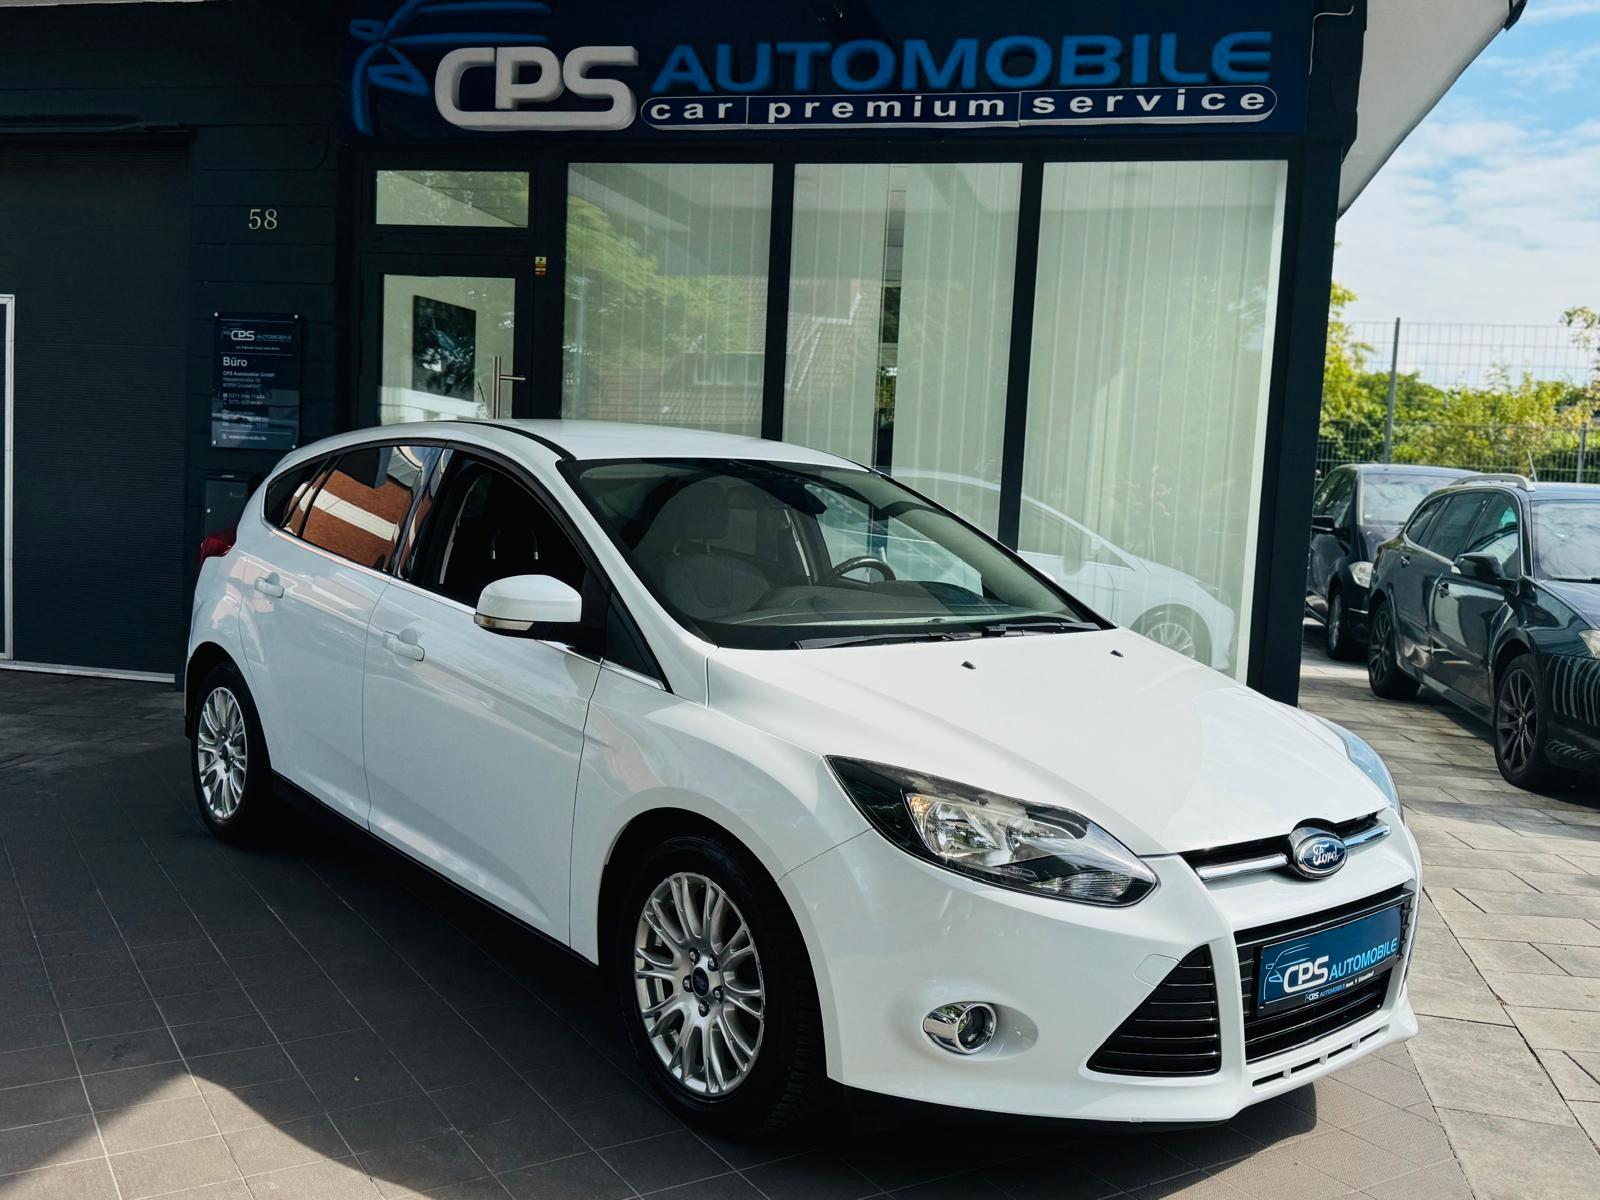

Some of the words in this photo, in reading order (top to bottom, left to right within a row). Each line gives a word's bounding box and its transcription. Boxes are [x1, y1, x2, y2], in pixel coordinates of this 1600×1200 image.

[435, 46, 638, 131] CPS
[651, 31, 1273, 93] AUTOMOBILE
[651, 101, 733, 120] car
[768, 95, 1005, 124] premium
[1032, 89, 1266, 115] service
[248, 208, 278, 230] 58
[230, 330, 255, 341] CPS
[223, 356, 248, 367] Büro
[1312, 843, 1341, 866] Ford
[1283, 955, 1329, 993] CPS
[1329, 937, 1398, 981] AUTOMOBILE
